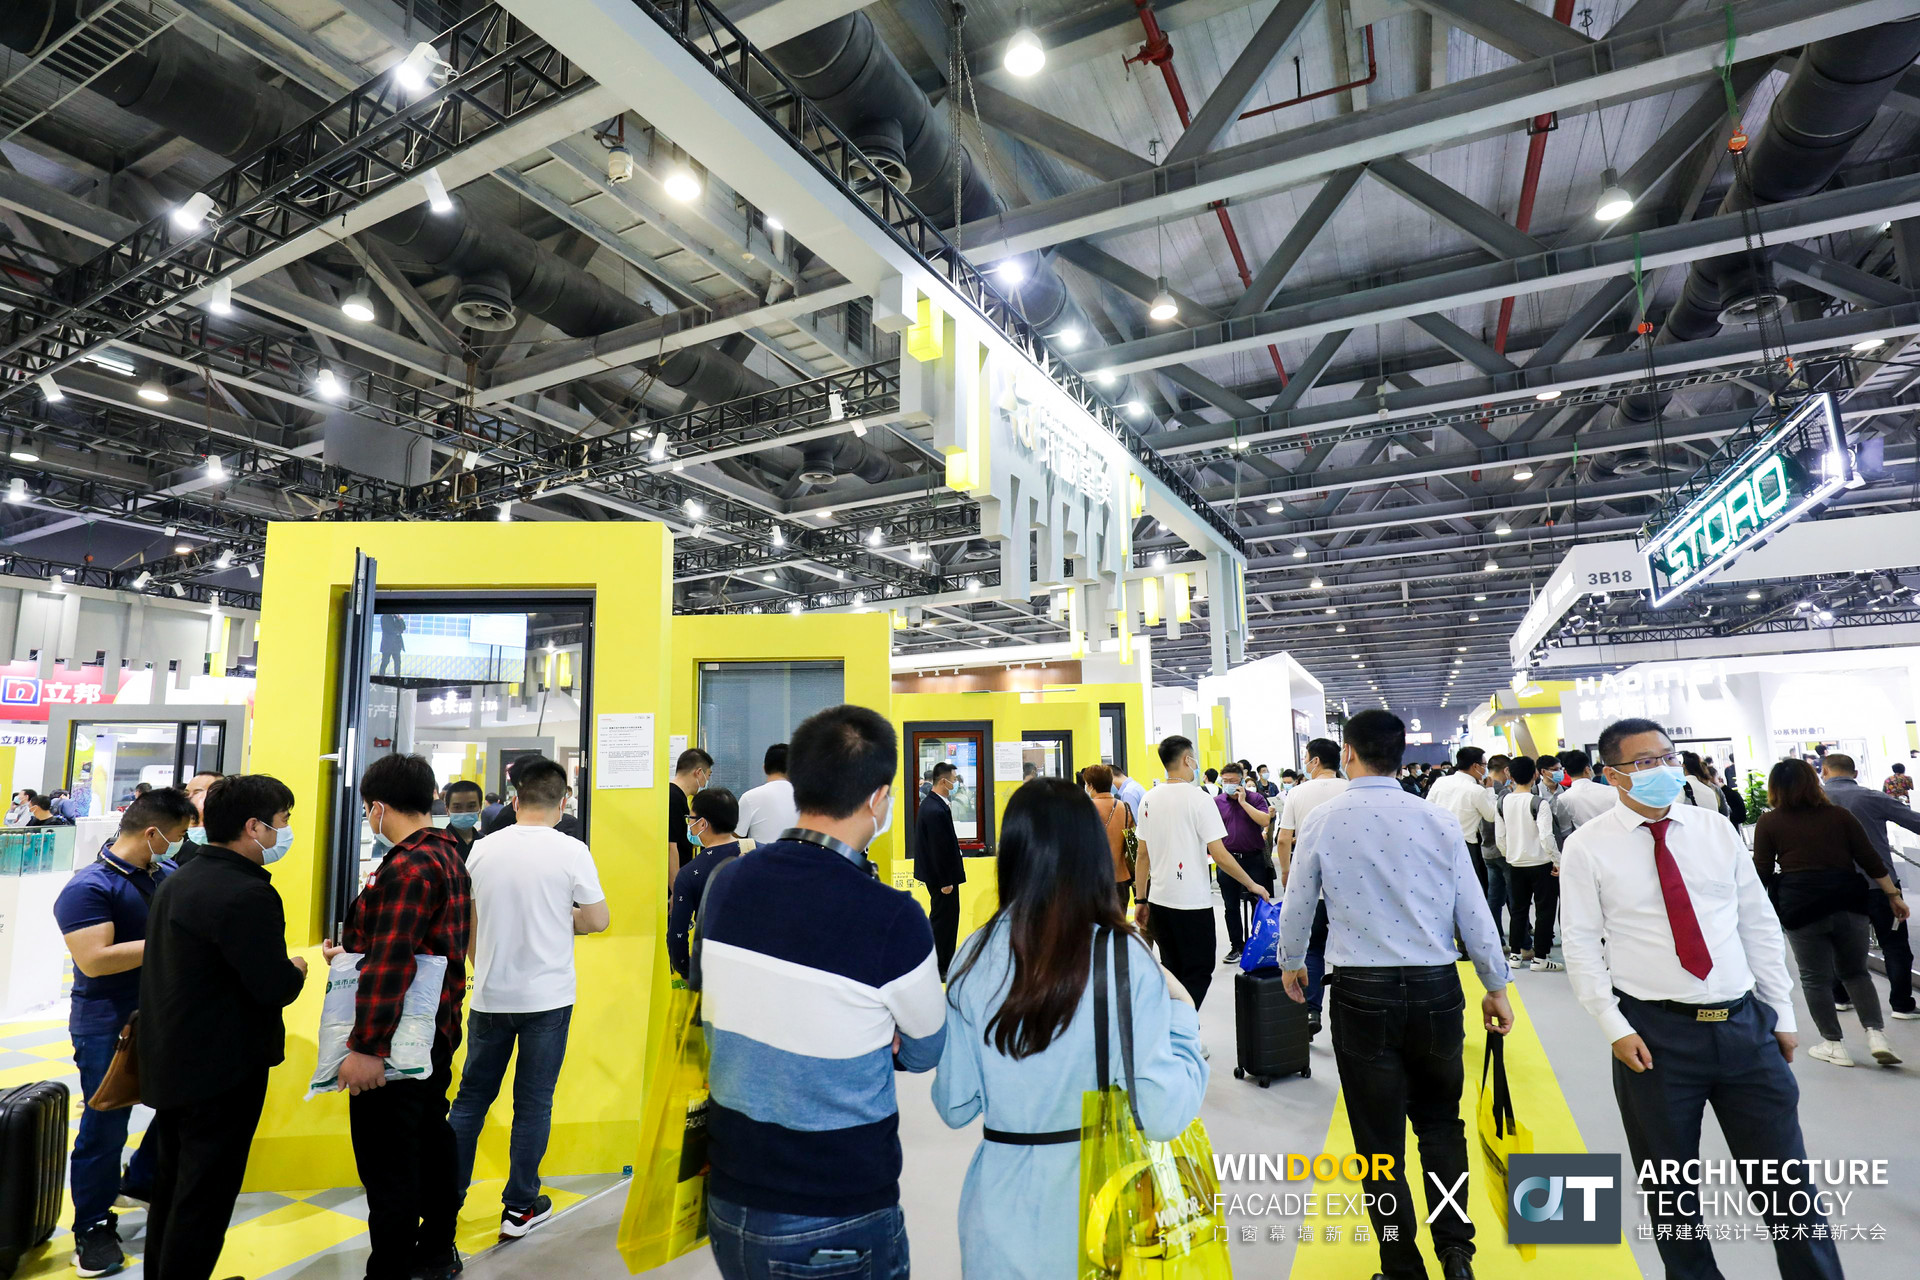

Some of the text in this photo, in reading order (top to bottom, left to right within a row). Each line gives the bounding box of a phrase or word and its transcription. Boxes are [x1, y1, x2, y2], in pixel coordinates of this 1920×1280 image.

[1588, 570, 1632, 585] 3B18
[42, 682, 102, 704] 立邦
[1410, 718, 1422, 732] 3
